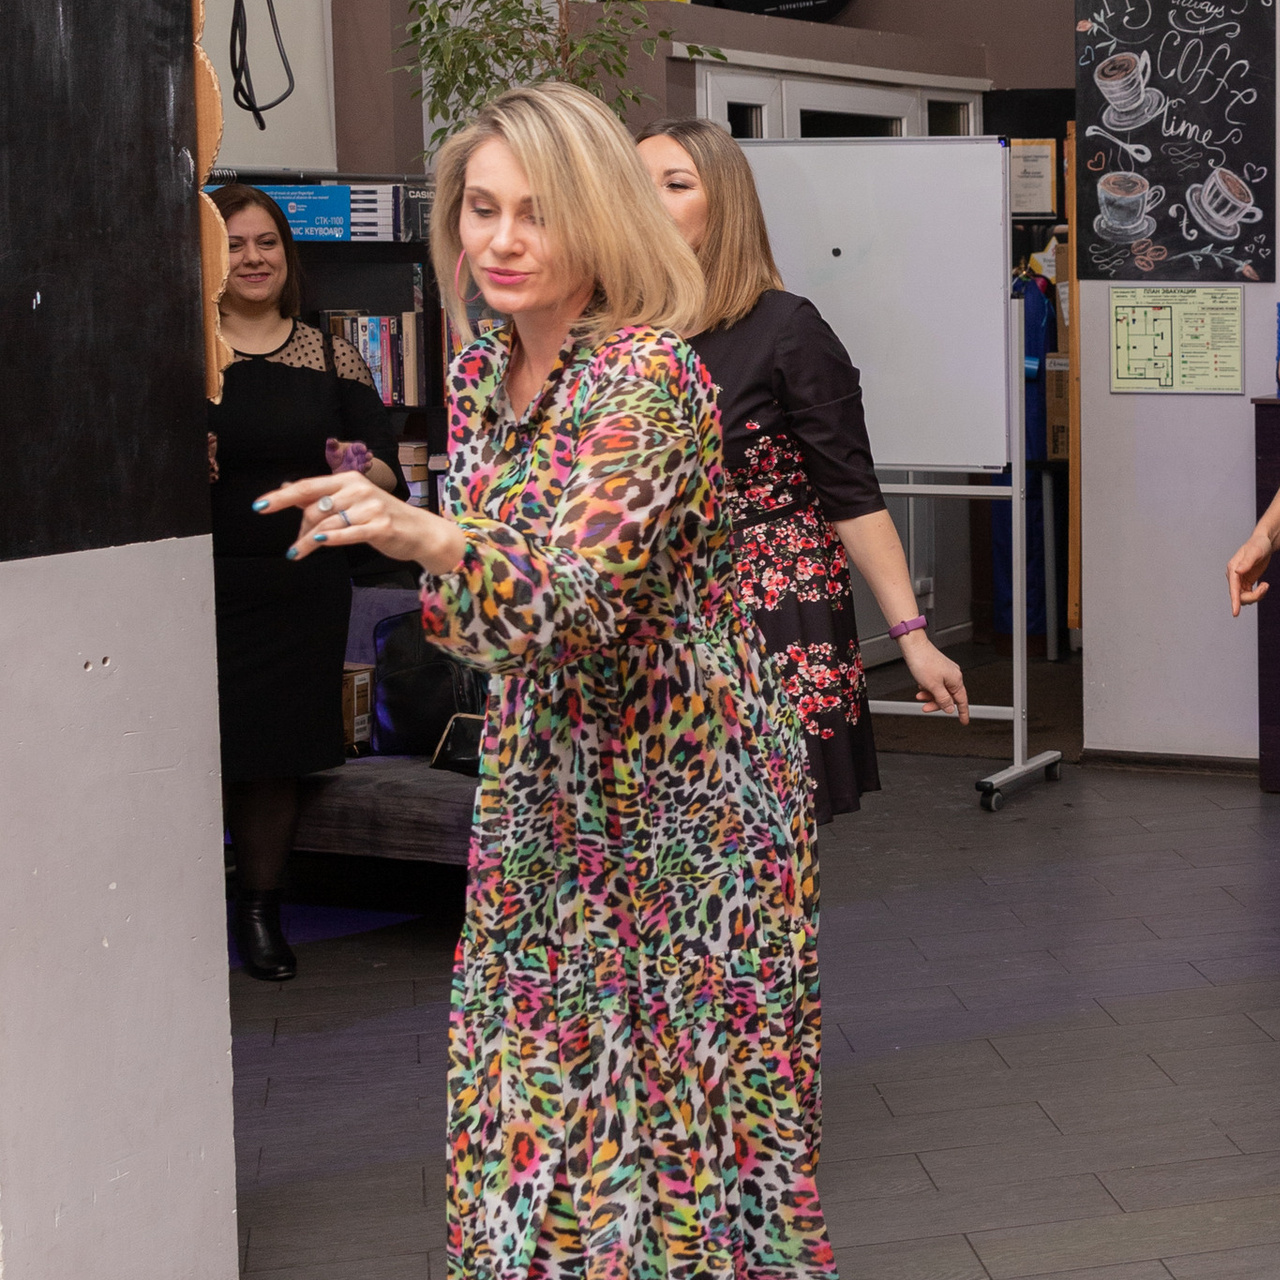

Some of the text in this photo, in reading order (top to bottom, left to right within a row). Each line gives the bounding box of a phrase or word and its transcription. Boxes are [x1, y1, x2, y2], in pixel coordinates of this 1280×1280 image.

[408, 190, 435, 199] CASIO
[314, 216, 344, 225] CTK-1100
[304, 227, 344, 236] KEYBOARD
